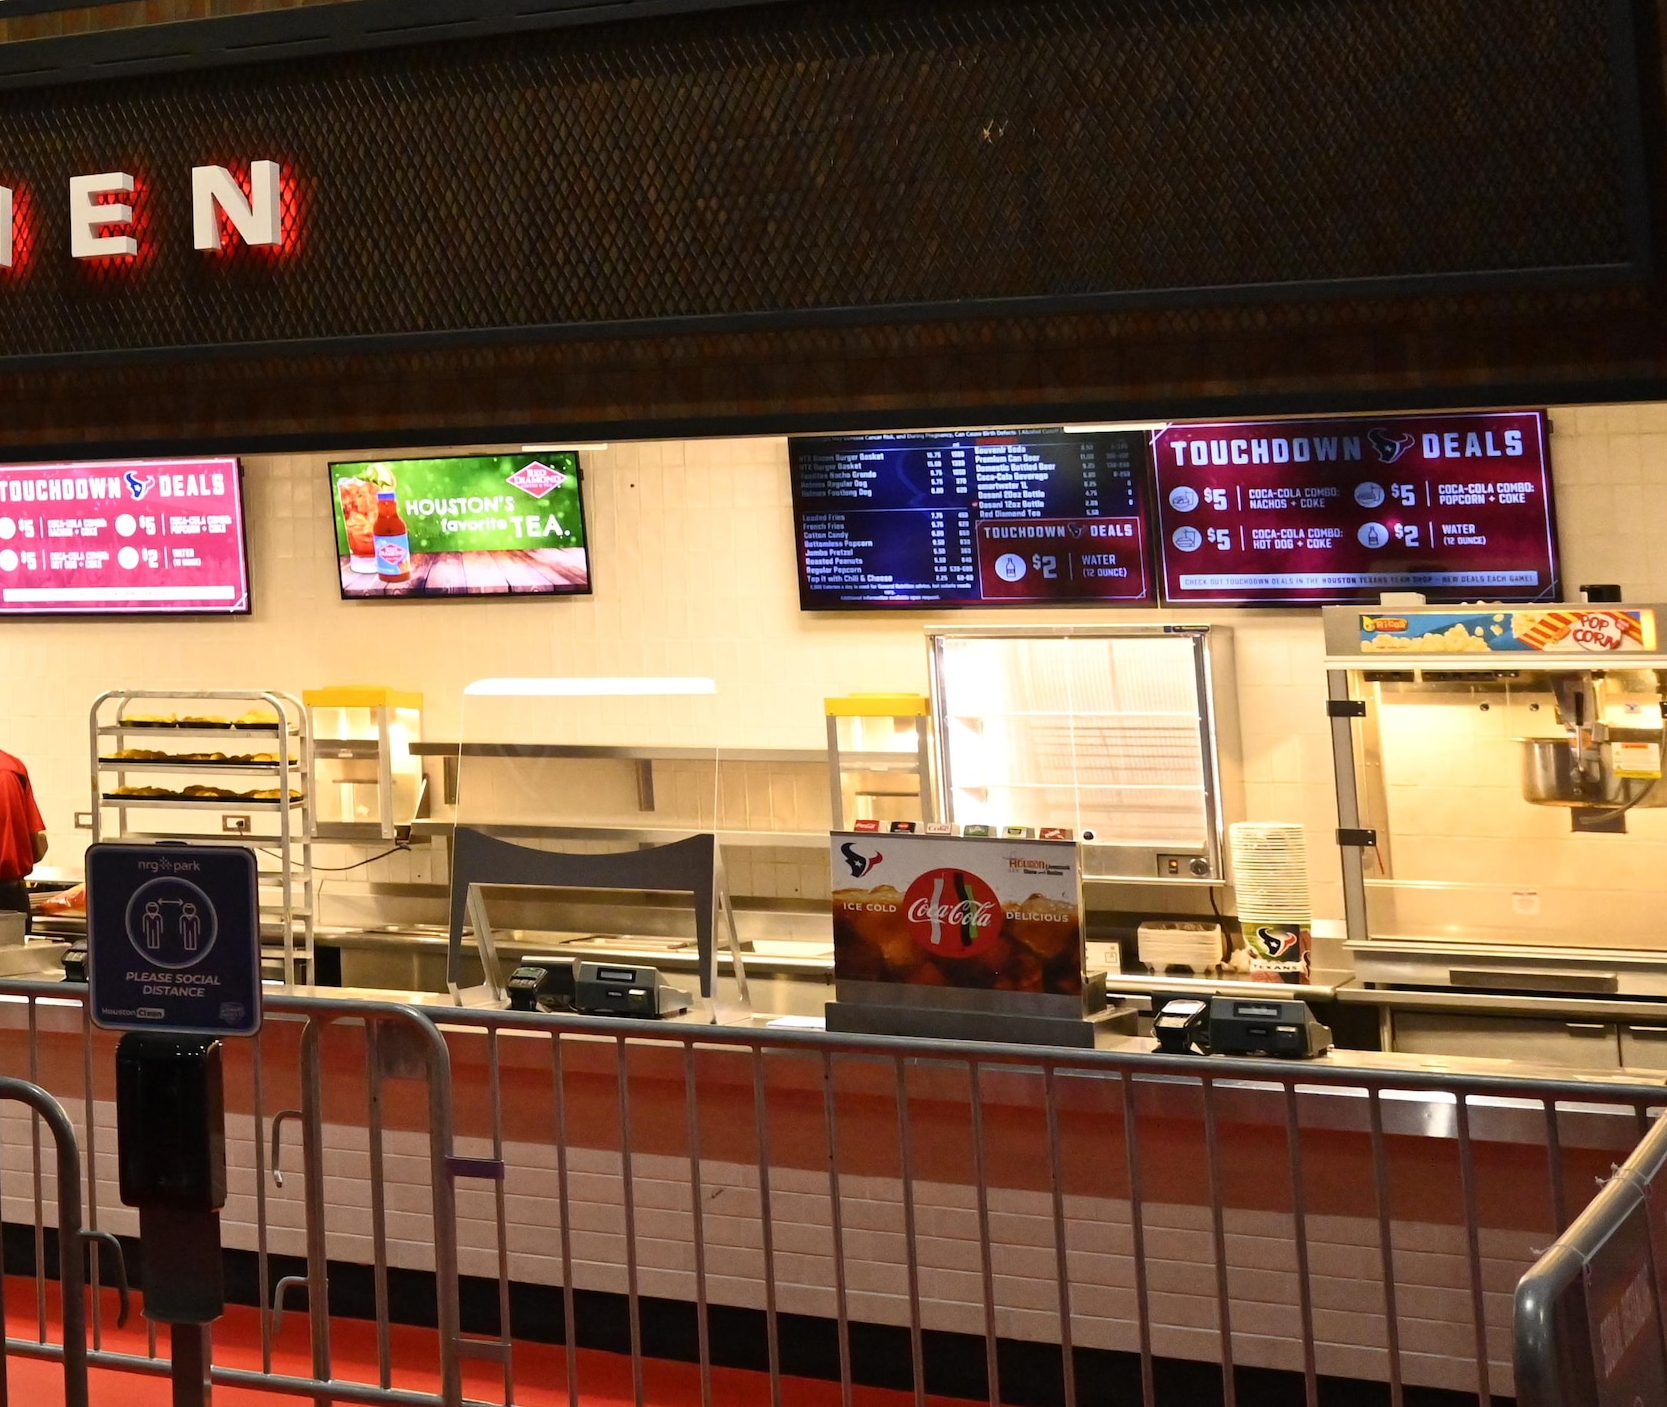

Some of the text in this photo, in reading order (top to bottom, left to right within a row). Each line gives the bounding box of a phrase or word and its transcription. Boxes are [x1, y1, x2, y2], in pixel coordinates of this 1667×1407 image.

[1170, 430, 1523, 466] TOUCHDOWN DEALS
[159, 473, 224, 497] DEALS
[1438, 483, 1534, 494] COCA-COLA COMBO:
[1204, 487, 1227, 510] $5
[1249, 488, 1339, 499] COCA-COLA COMBO:
[1391, 483, 1415, 506] $5
[1439, 495, 1485, 505] POPCORN
[1499, 494, 1525, 503] COKE
[406, 496, 515, 516] HOUSTON'S
[1250, 499, 1287, 509] NACHOS
[1301, 498, 1325, 508] COKE
[441, 514, 570, 538] favorite TEA.
[984, 524, 1132, 538] TOUCHDOWN DEALS
[1442, 524, 1475, 534] WATER
[1207, 527, 1230, 551] $5
[1252, 528, 1343, 538] COCA-COLA COMBO:
[1394, 523, 1419, 547] $2
[1253, 540, 1271, 549] HOT
[1275, 539, 1294, 549] DOG
[1307, 539, 1332, 549] COKE
[1443, 536, 1486, 545] (12 OUNCE)
[1082, 555, 1116, 565] WATER
[1032, 554, 1057, 579] $2
[1083, 567, 1127, 577] (12 OUNCE)
[1580, 615, 1608, 629] POP
[1573, 629, 1619, 646] CORN
[138, 861, 200, 872] nrg park
[844, 903, 897, 913] ICE COLD
[907, 897, 995, 927] Coca-Cola
[1006, 912, 1068, 922] DELICIOUS
[126, 972, 221, 985] PLEASE SOCIAL
[143, 985, 205, 997] DISTANCE
[102, 1007, 162, 1017] Houston Clean
